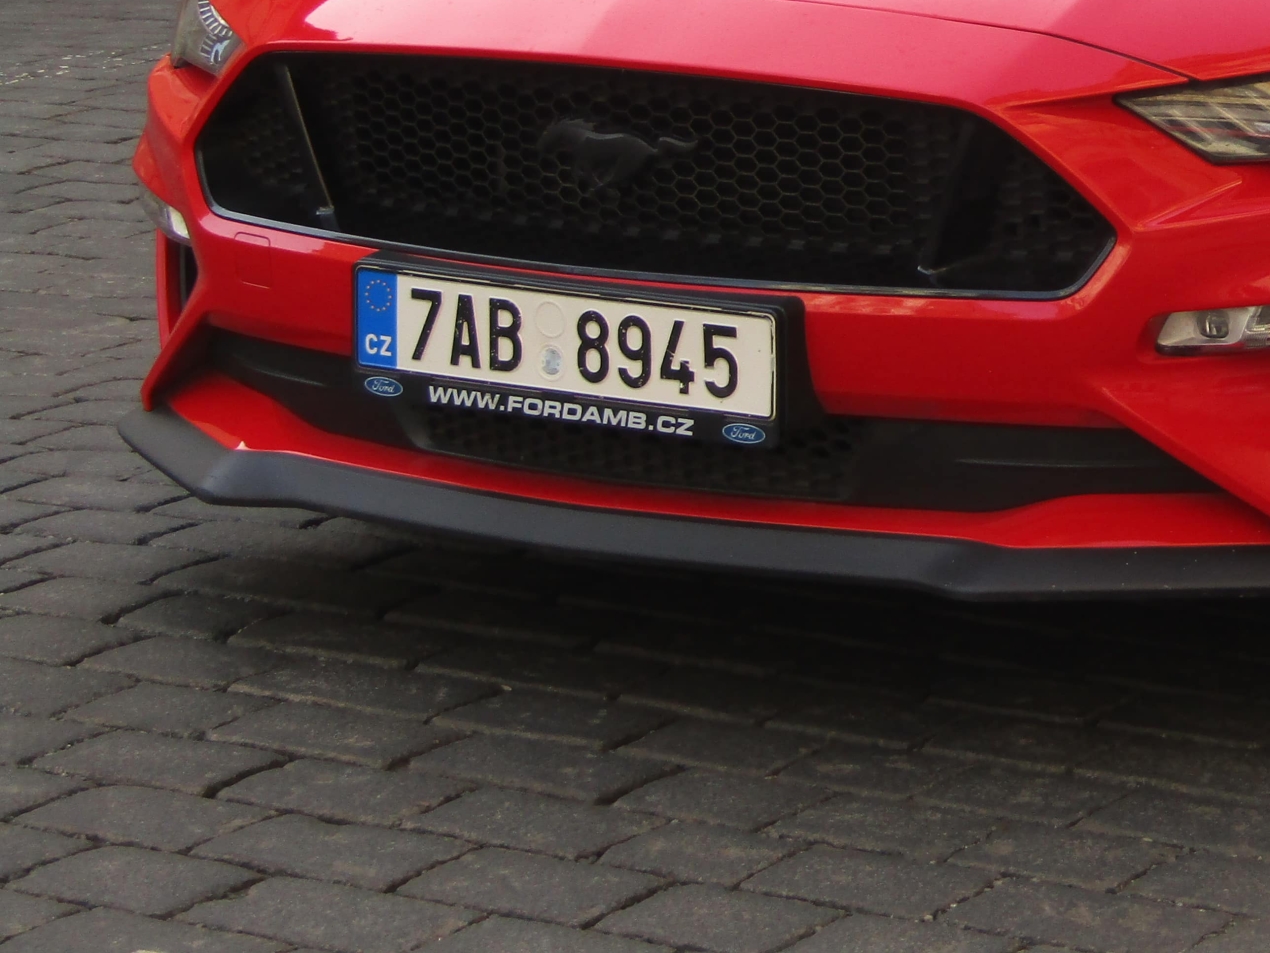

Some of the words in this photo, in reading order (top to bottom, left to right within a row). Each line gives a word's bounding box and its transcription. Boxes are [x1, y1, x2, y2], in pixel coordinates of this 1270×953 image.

[365, 333, 392, 357] CZ
[411, 287, 523, 372] 7AB
[576, 309, 738, 398] 8945
[428, 385, 695, 437] WWW.FORDAMB.CZ
